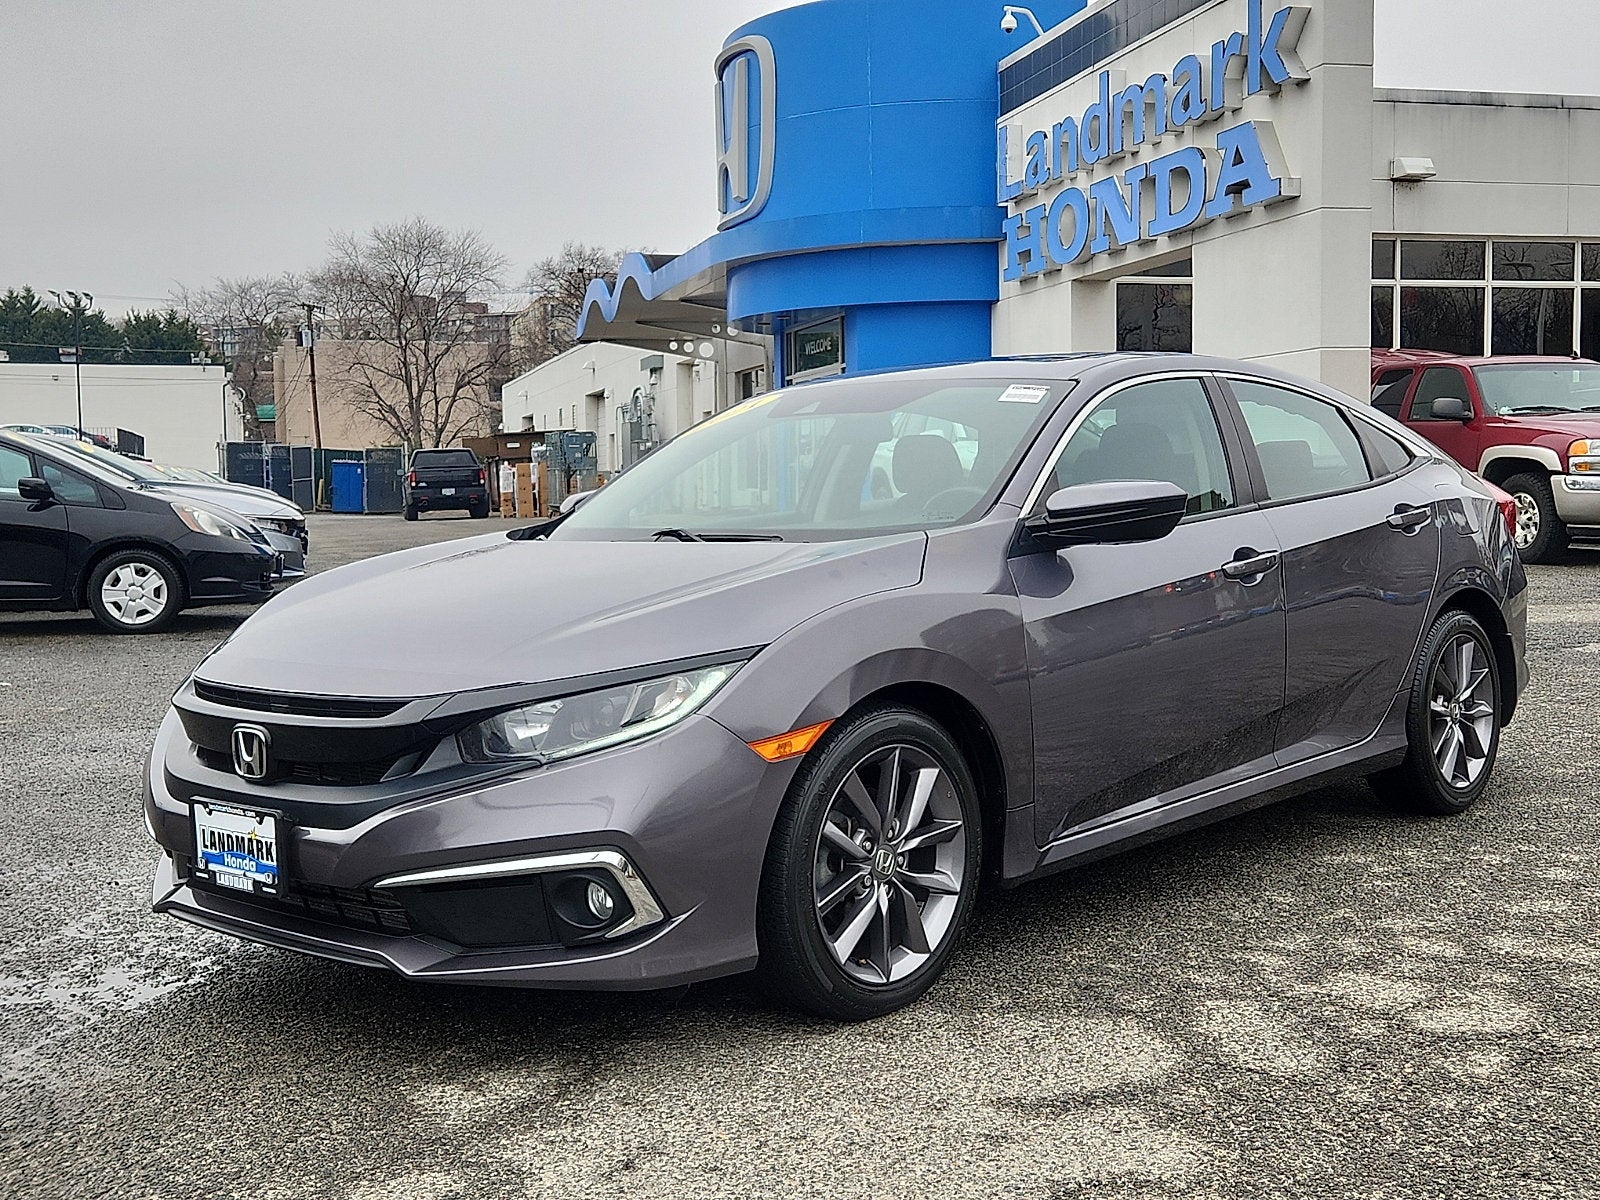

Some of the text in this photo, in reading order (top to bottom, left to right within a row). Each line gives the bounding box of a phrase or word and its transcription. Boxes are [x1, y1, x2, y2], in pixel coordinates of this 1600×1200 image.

[998, 0, 1296, 205] Landmark
[1002, 120, 1284, 283] HONDA
[804, 337, 832, 356] WELCOME
[201, 828, 275, 863] LANDMARK
[224, 853, 257, 872] Honda
